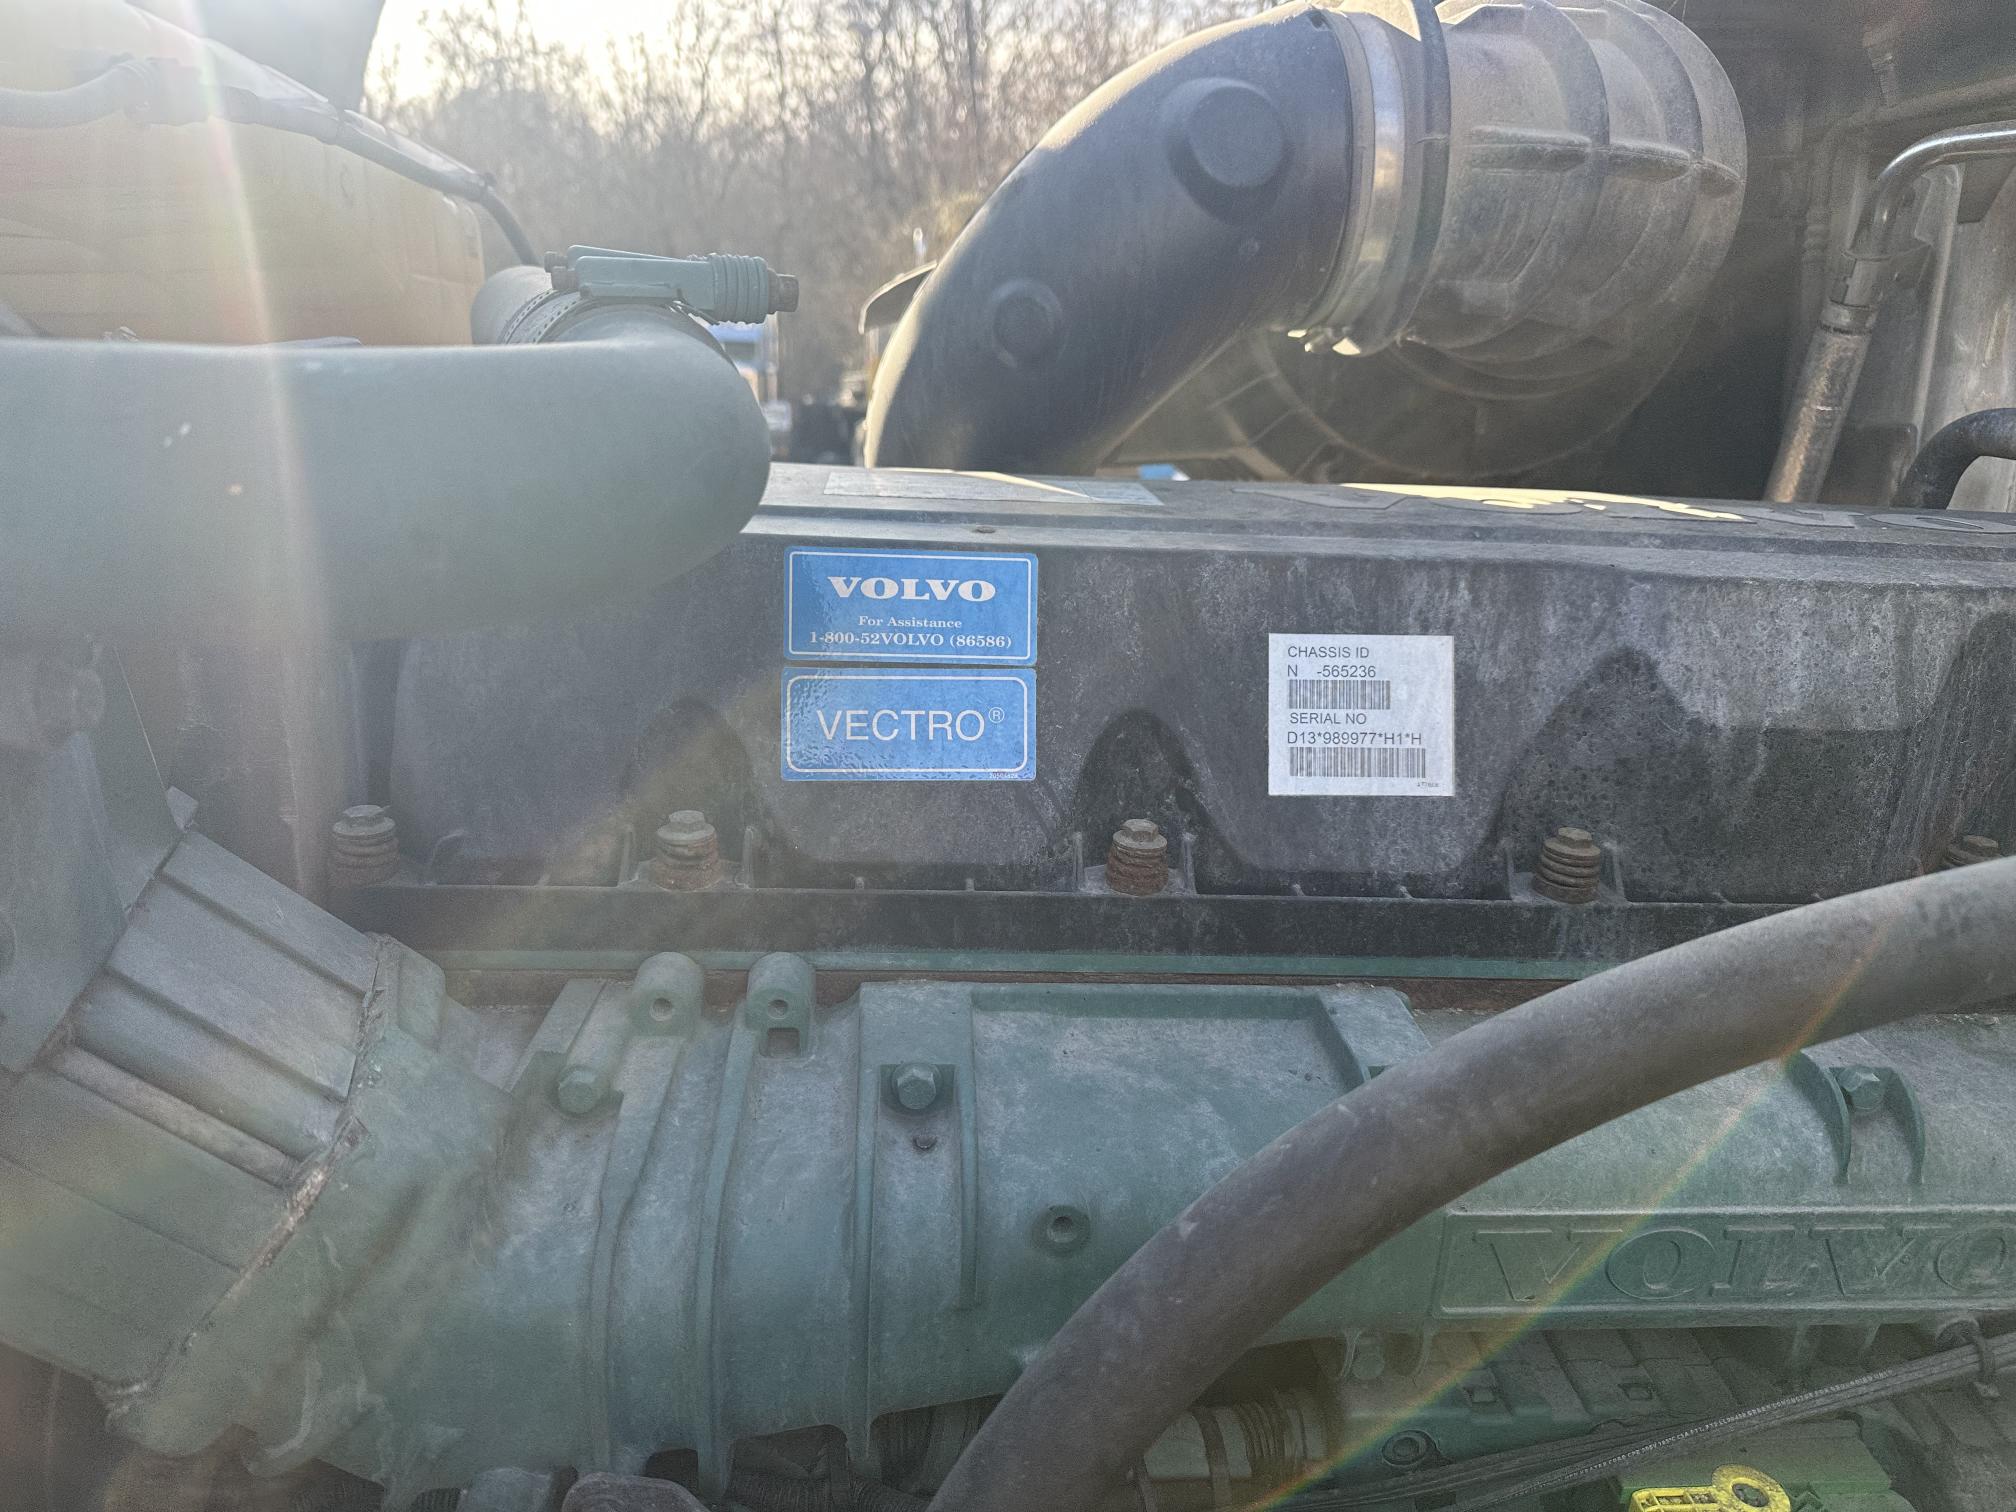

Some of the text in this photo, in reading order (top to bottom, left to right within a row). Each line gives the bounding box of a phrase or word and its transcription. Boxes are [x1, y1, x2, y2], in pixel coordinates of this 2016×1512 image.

[827, 576, 996, 601] VOLVO
[858, 615, 962, 628] For Assistance
[810, 631, 1012, 648] 1-800-52VOLVO (86586)
[1287, 646, 1370, 658] CHASSIS ID
[1287, 665, 1377, 678] N -565236
[1289, 713, 1368, 725] SERIAL NO
